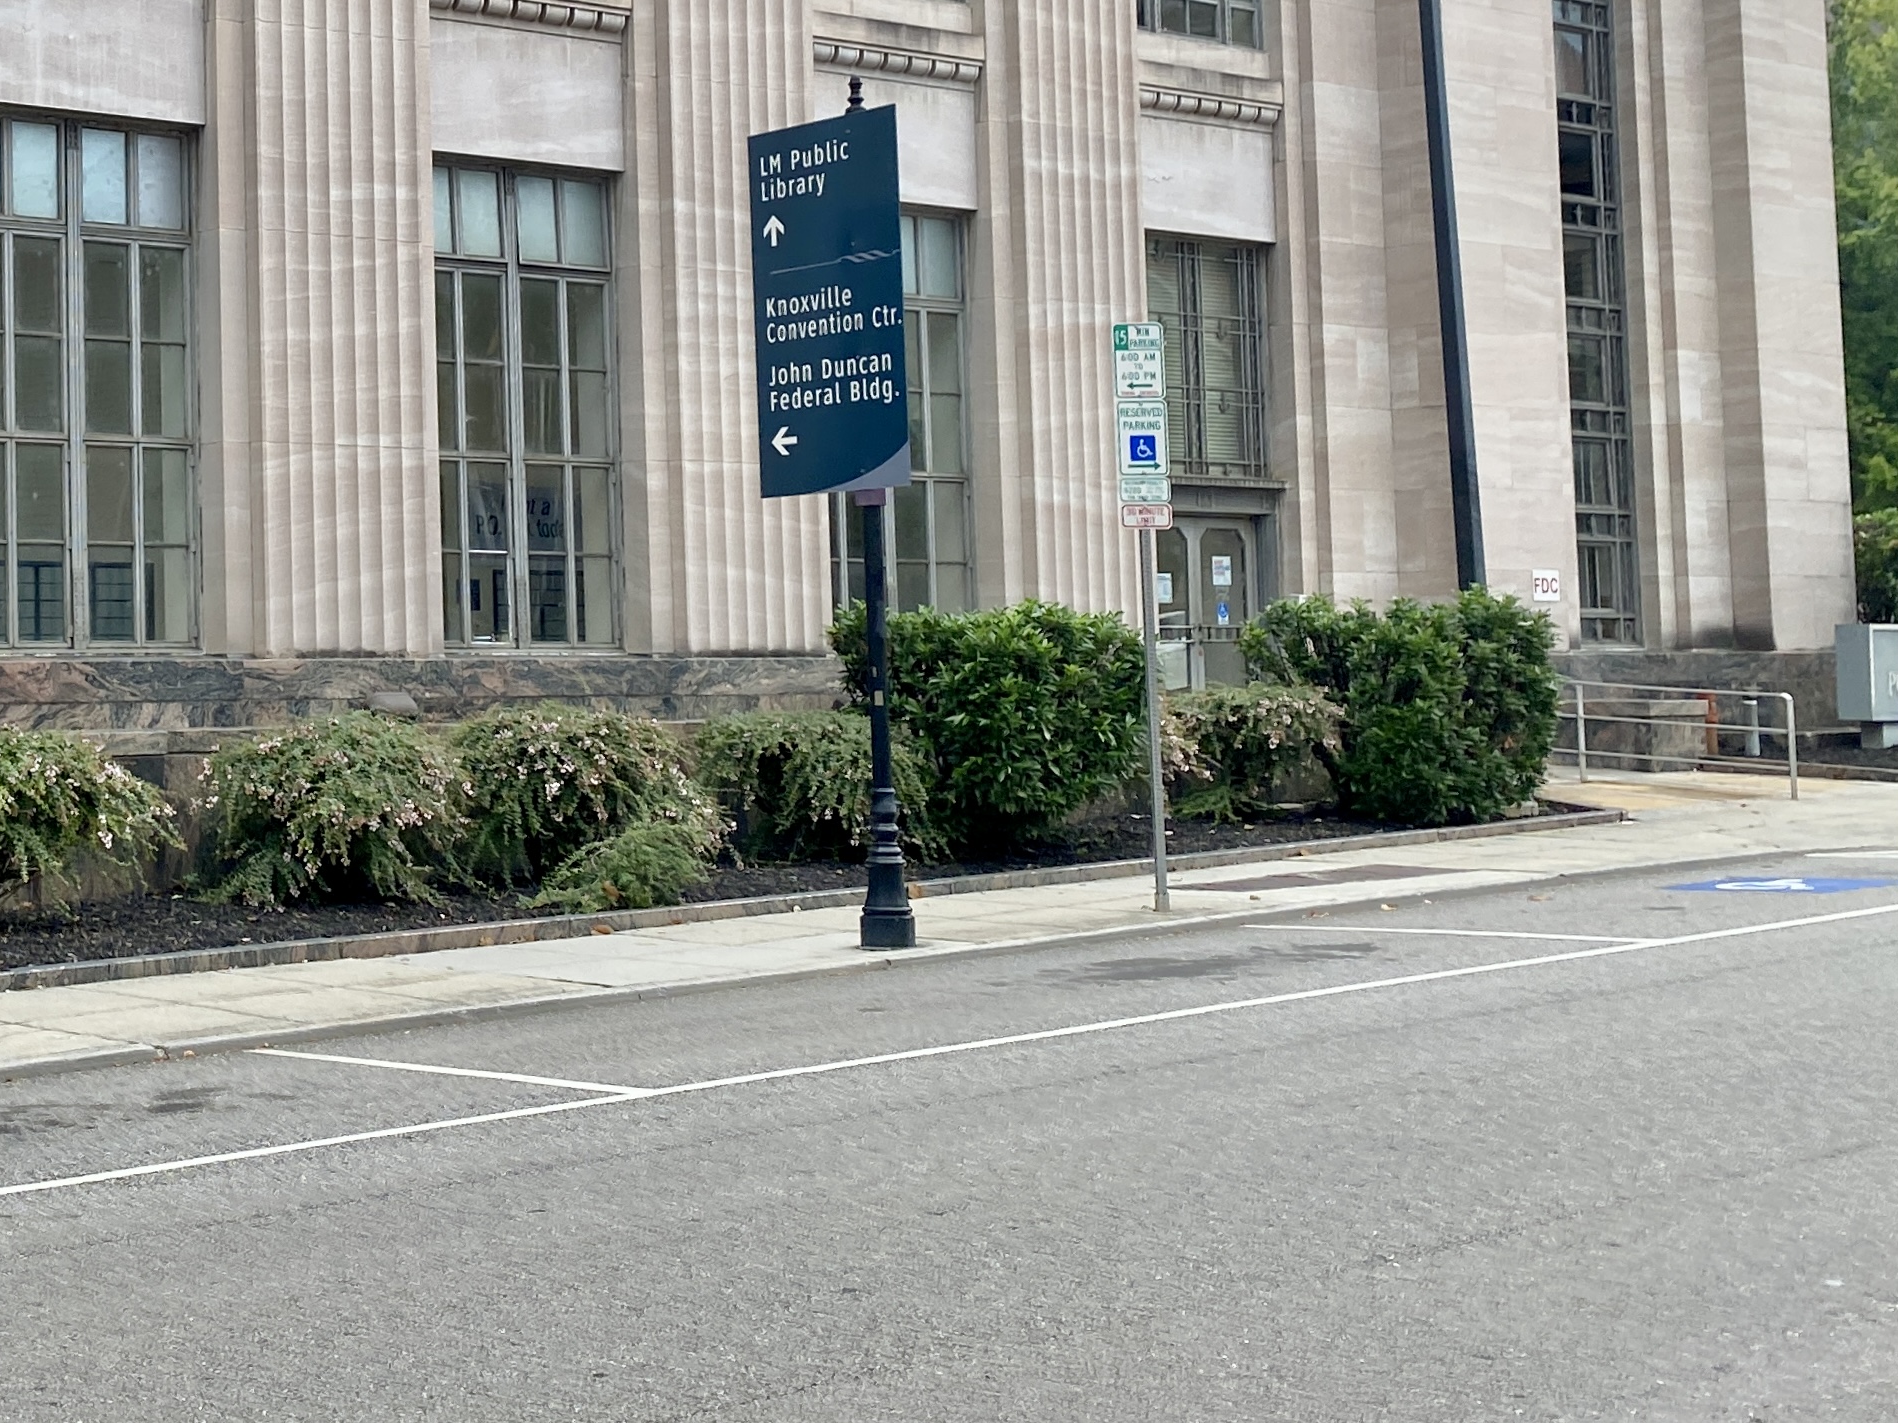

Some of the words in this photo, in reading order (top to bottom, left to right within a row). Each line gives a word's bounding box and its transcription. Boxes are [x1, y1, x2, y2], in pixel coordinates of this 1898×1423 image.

[760, 153, 781, 177] LM
[790, 139, 849, 171] Public
[761, 172, 825, 202] Library
[765, 285, 852, 318] Knoxville
[766, 311, 864, 344] Convention
[872, 304, 902, 328] Ctr.
[1114, 329, 1127, 346] 15
[1143, 352, 1156, 361] AM
[768, 362, 812, 387] John
[821, 353, 892, 380] Duncan
[1143, 371, 1157, 380] PM
[769, 381, 842, 412] Federal
[849, 376, 900, 404] Bldg.
[1119, 407, 1163, 417] RESERVED
[1123, 420, 1162, 431] PARKING
[1533, 577, 1559, 594] FDC
